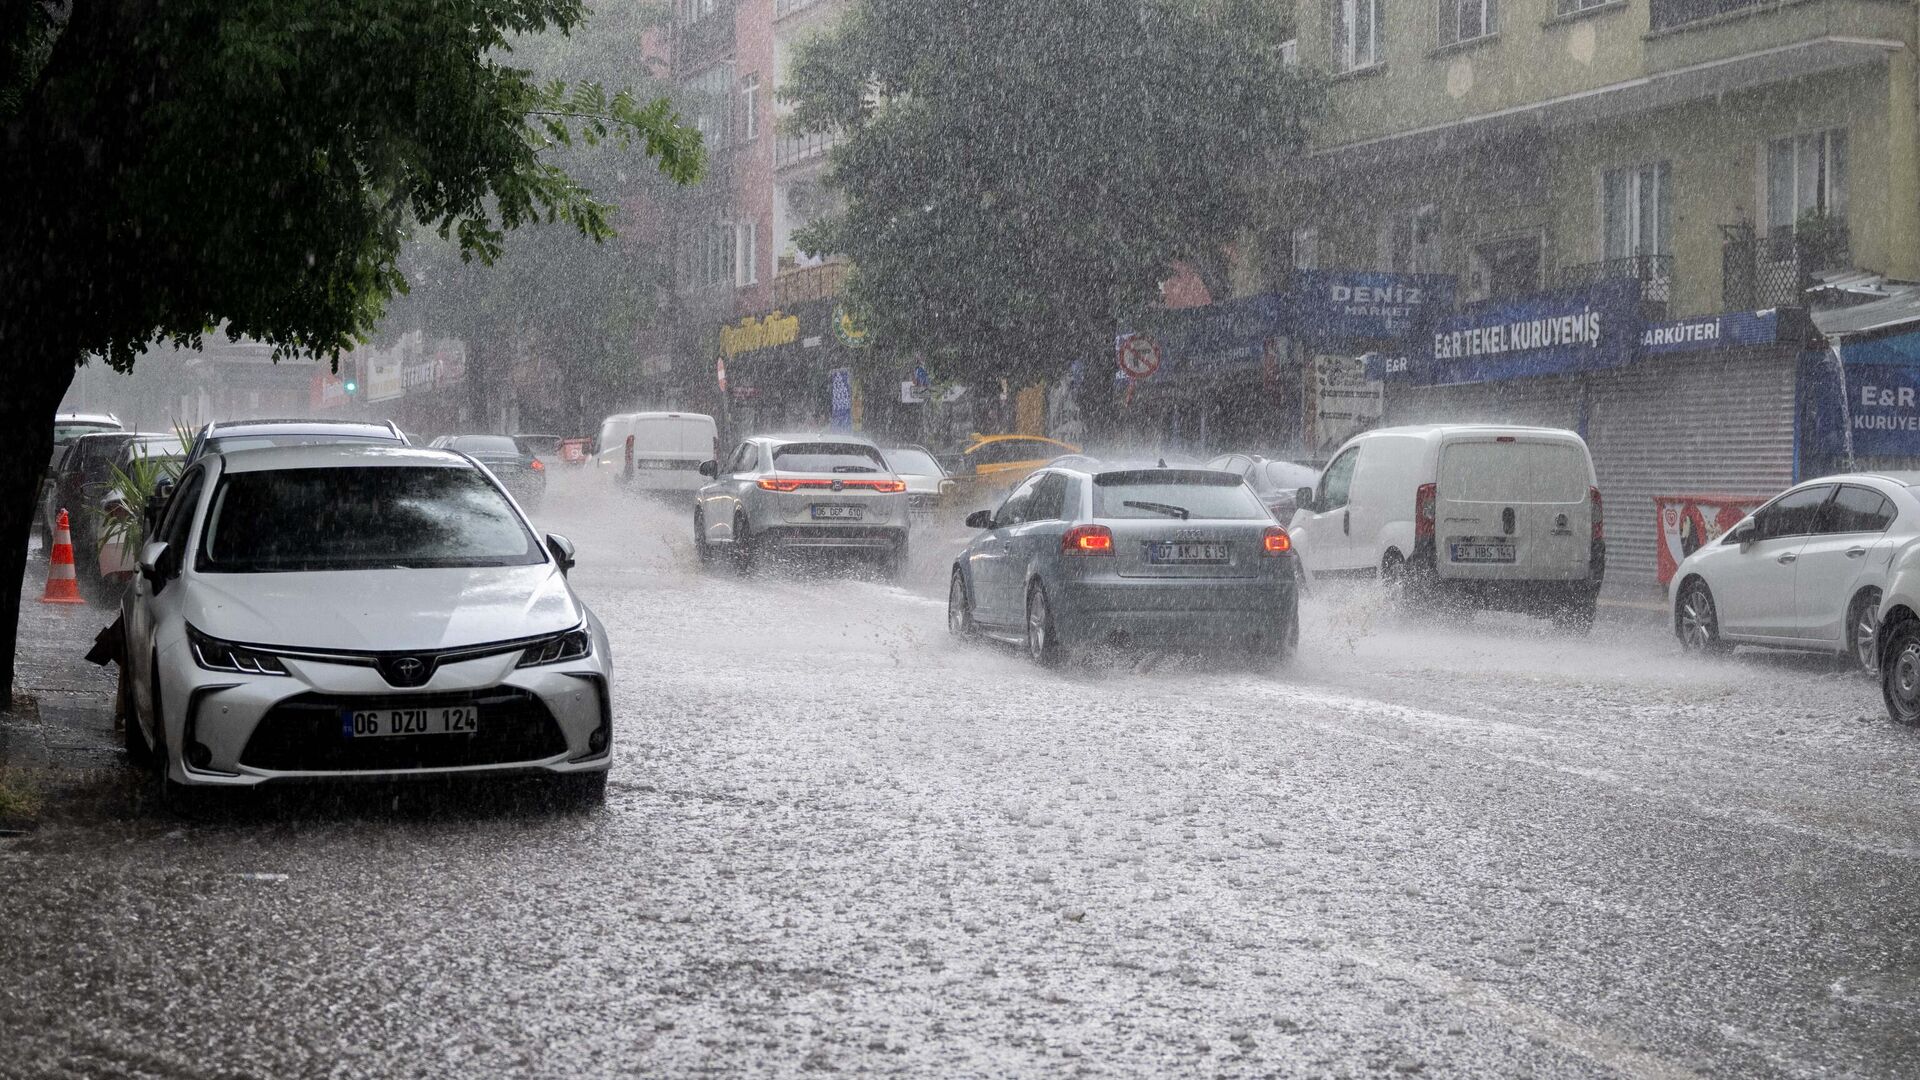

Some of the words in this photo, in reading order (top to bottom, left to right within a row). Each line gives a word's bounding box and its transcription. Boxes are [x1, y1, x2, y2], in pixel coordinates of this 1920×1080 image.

[1331, 284, 1421, 304] DENİZ
[1344, 305, 1411, 317] MARKET
[1434, 331, 1462, 359] E&R
[1465, 324, 1508, 356] TEKEL
[1511, 305, 1600, 350] KURUYEMİŞ
[1385, 356, 1407, 373] E&R
[1861, 385, 1915, 407] E&R
[1854, 415, 1920, 431] KURUYE
[1159, 545, 1173, 559] 07
[1458, 547, 1470, 558] 34
[354, 711, 379, 735] 06
[391, 710, 428, 733] DZU
[442, 708, 476, 732] 124
